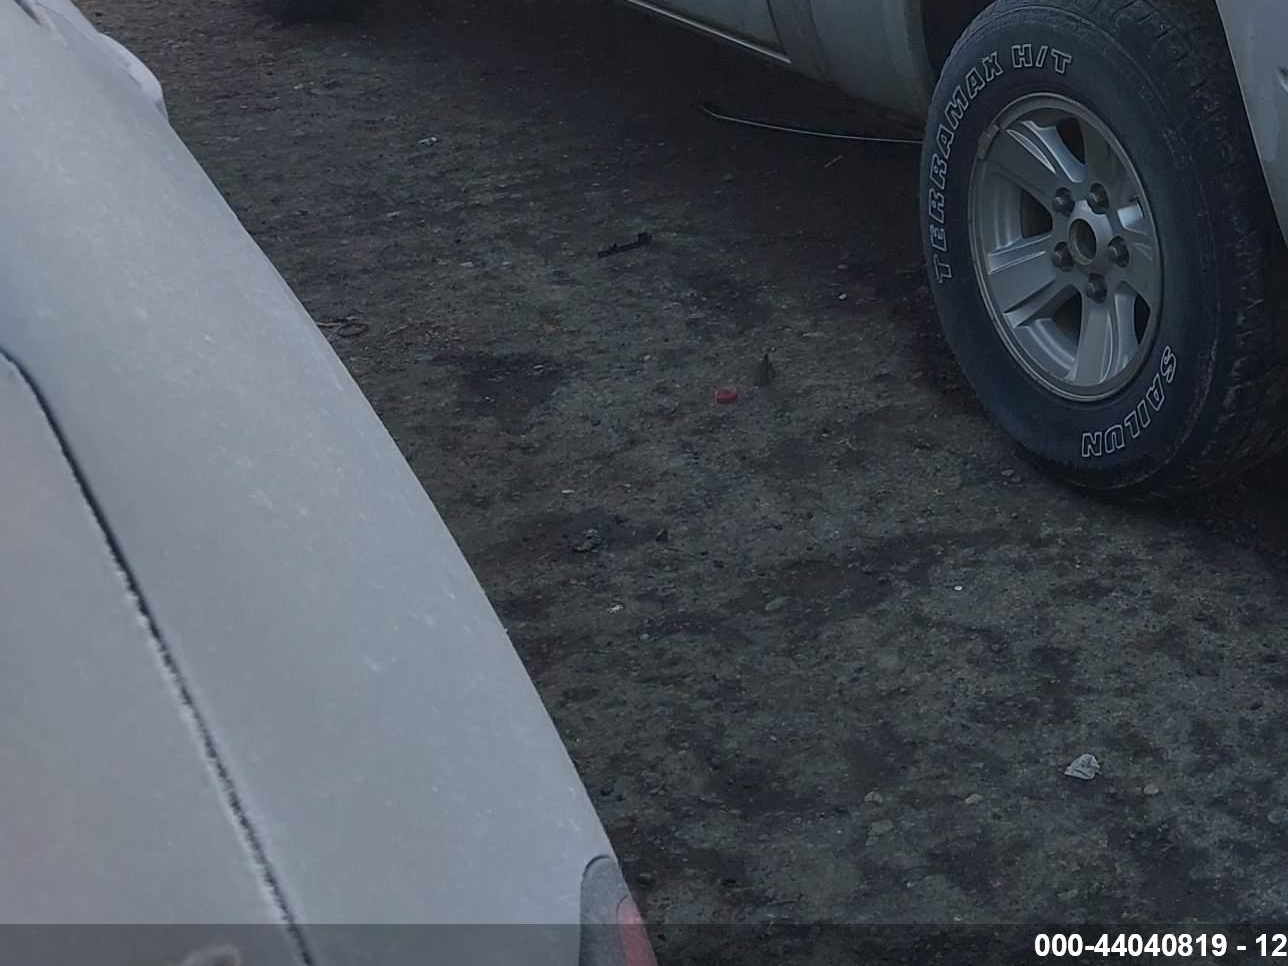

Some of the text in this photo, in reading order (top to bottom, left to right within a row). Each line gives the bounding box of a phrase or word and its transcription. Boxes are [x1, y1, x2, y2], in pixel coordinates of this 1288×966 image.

[926, 42, 1073, 284] TERRAMAX H/T
[1080, 345, 1178, 458] SAILUN
